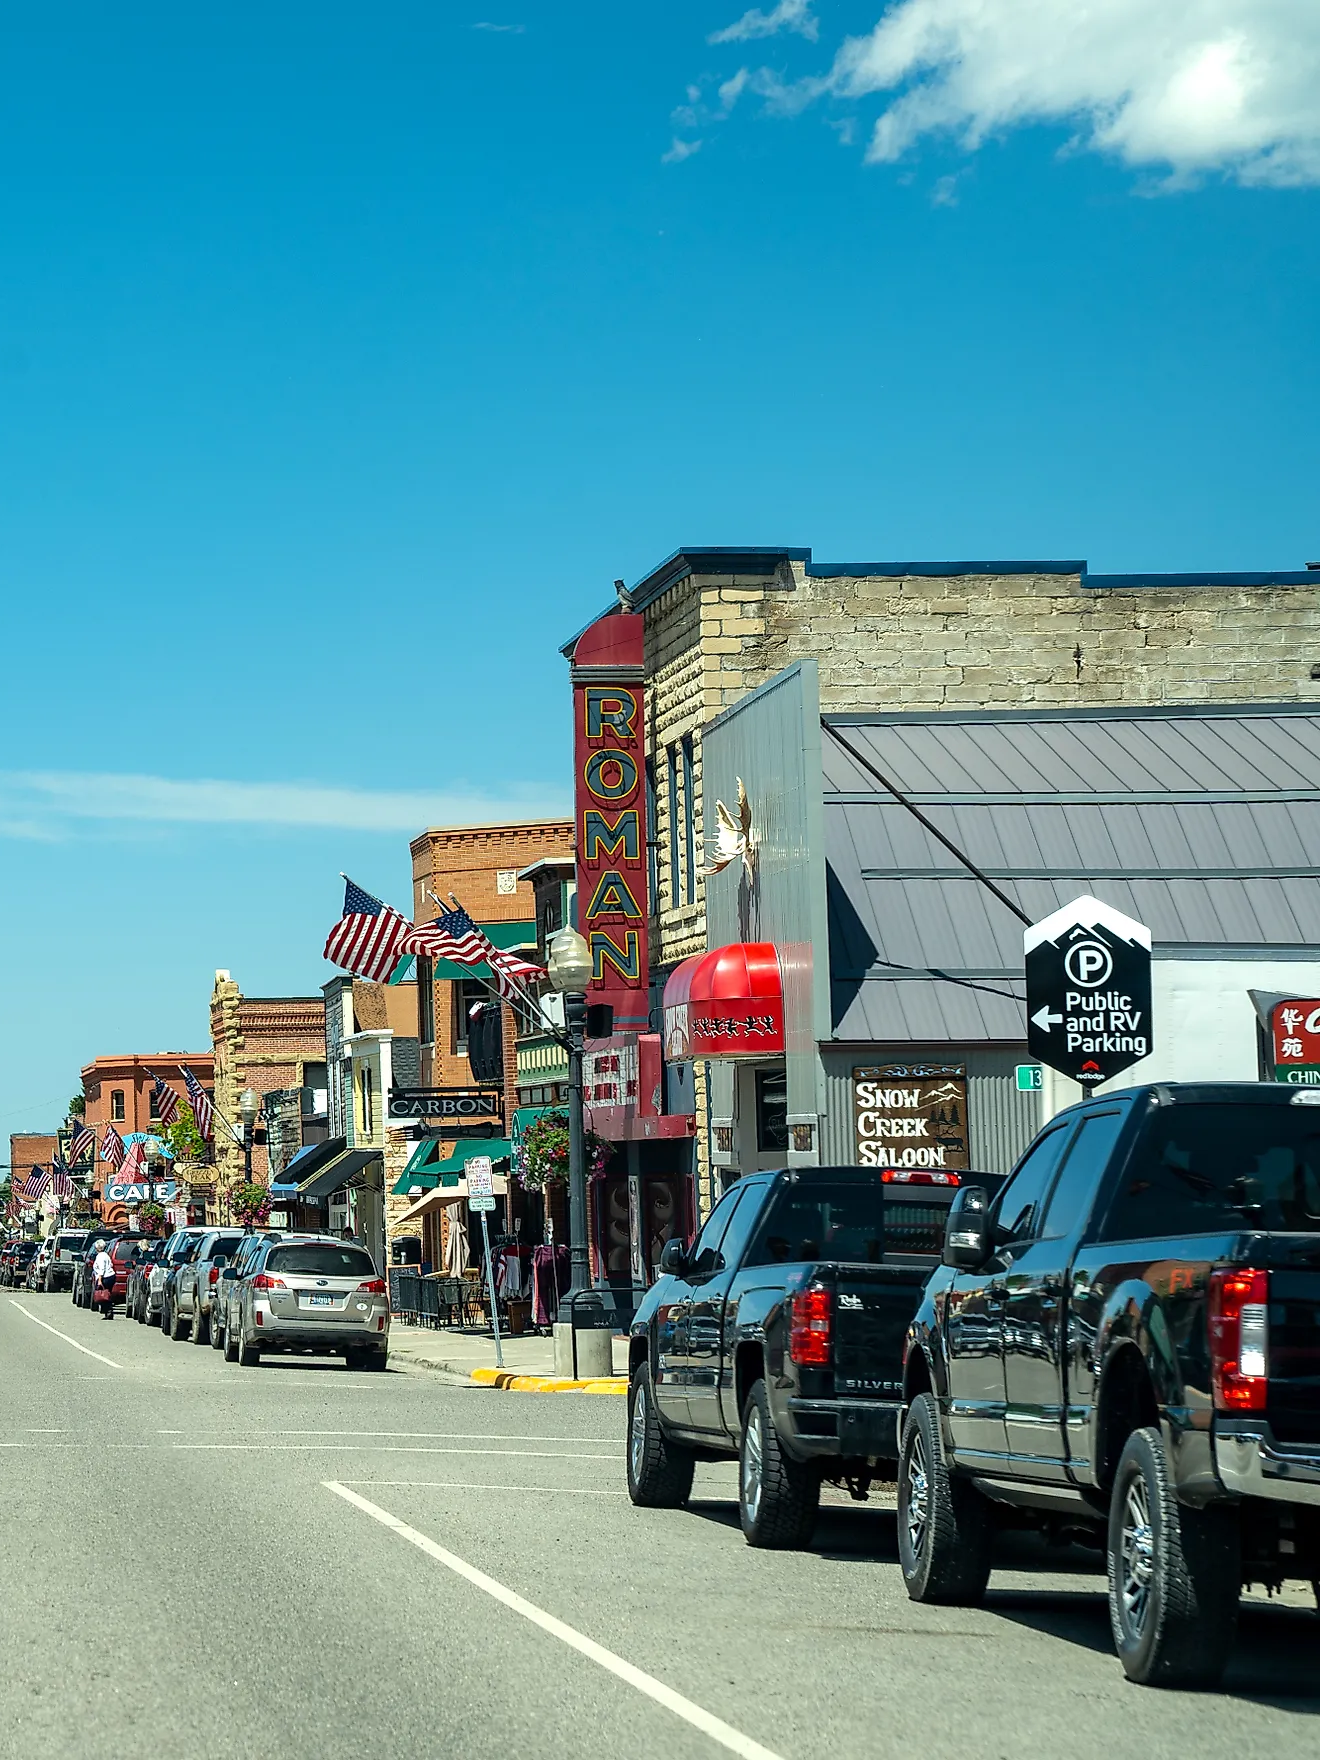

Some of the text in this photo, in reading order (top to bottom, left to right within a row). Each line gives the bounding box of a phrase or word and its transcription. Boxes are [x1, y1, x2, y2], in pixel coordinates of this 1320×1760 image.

[583, 685, 644, 981] ROMAN
[1065, 991, 1133, 1012] Public
[1065, 1012, 1142, 1032] and RV
[1279, 1007, 1305, 1058] 华苑
[1067, 1032, 1147, 1057] Parking
[1028, 1069, 1042, 1087] 13
[390, 1098, 494, 1115] CARBON
[855, 1081, 922, 1109] SNOW
[857, 1111, 930, 1138] CREEK
[858, 1140, 947, 1168] SALOON
